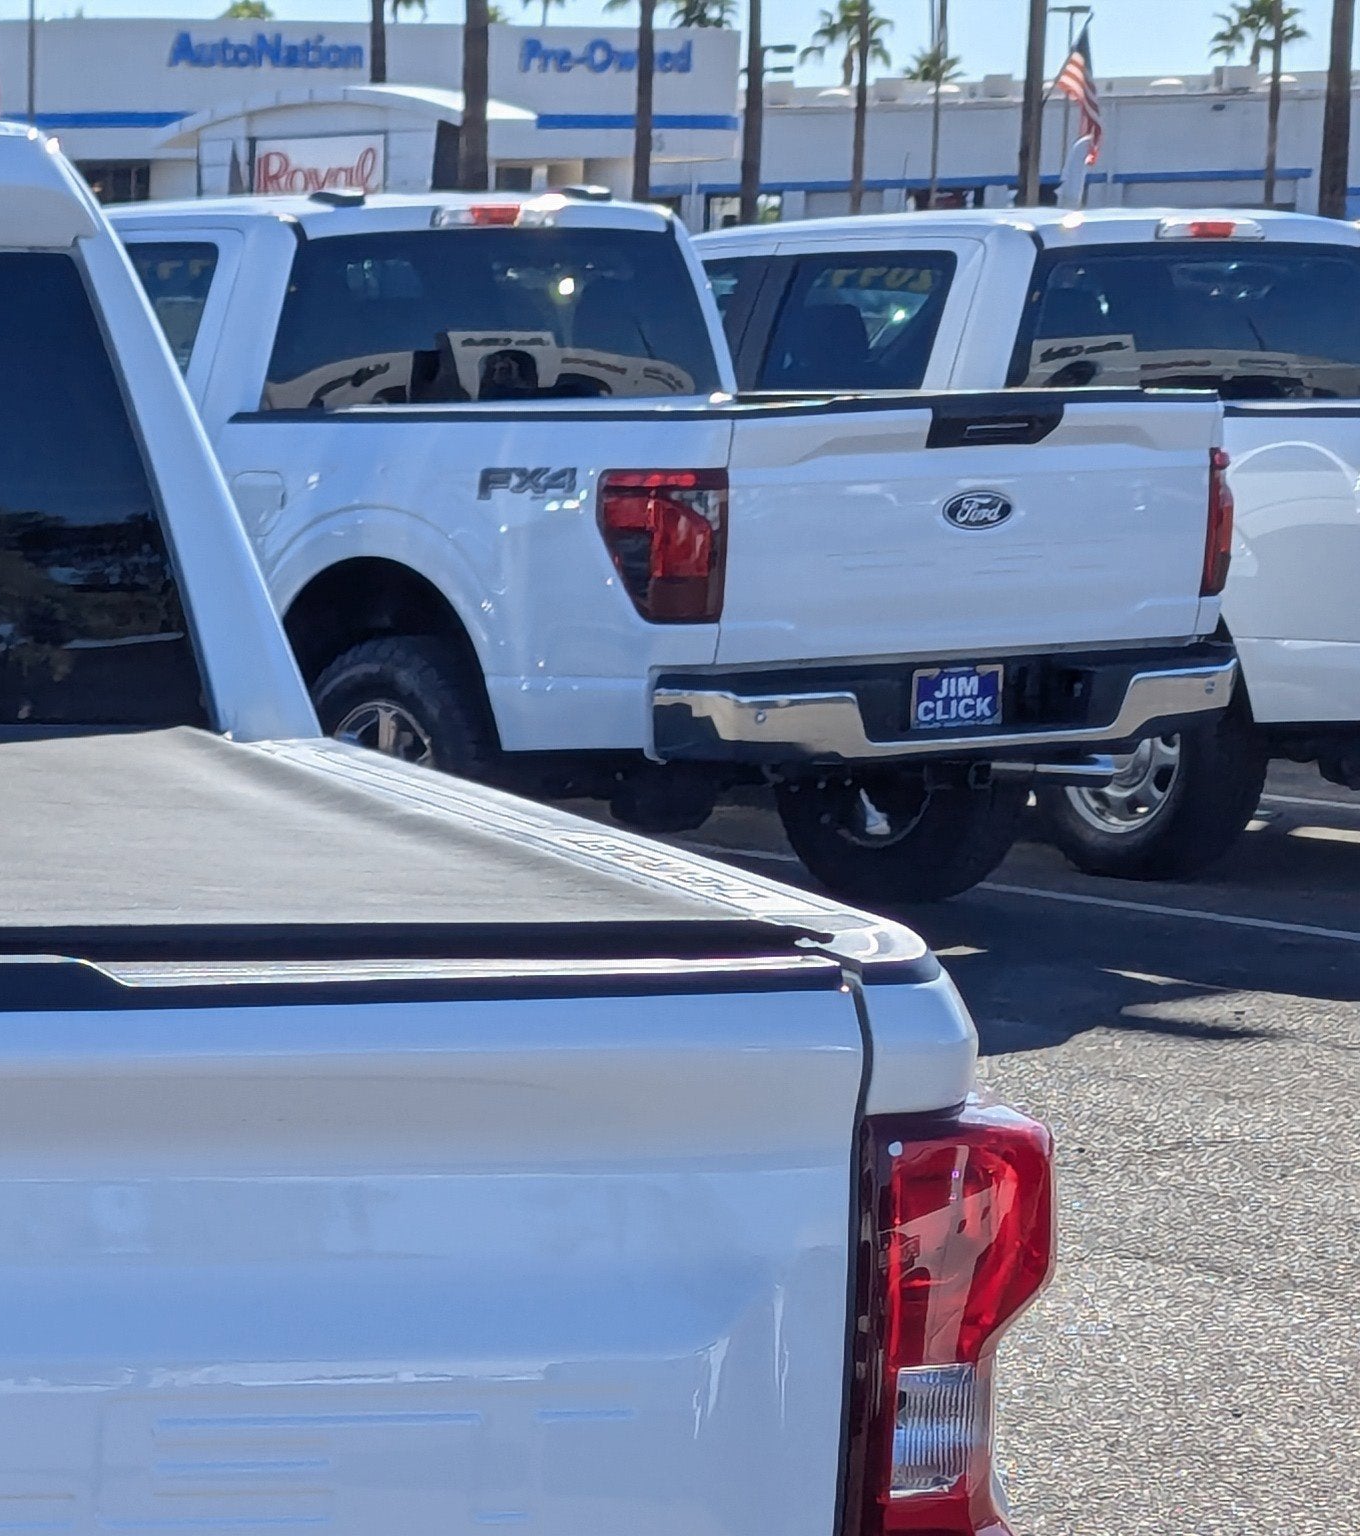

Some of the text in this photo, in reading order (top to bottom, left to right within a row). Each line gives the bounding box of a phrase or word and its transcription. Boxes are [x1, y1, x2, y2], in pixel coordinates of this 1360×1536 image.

[167, 31, 693, 73] AutoNation Pre-Owed
[477, 467, 578, 500] FX4
[956, 497, 1003, 523] Ford
[933, 675, 979, 699] JIM
[917, 696, 993, 722] CLICK
